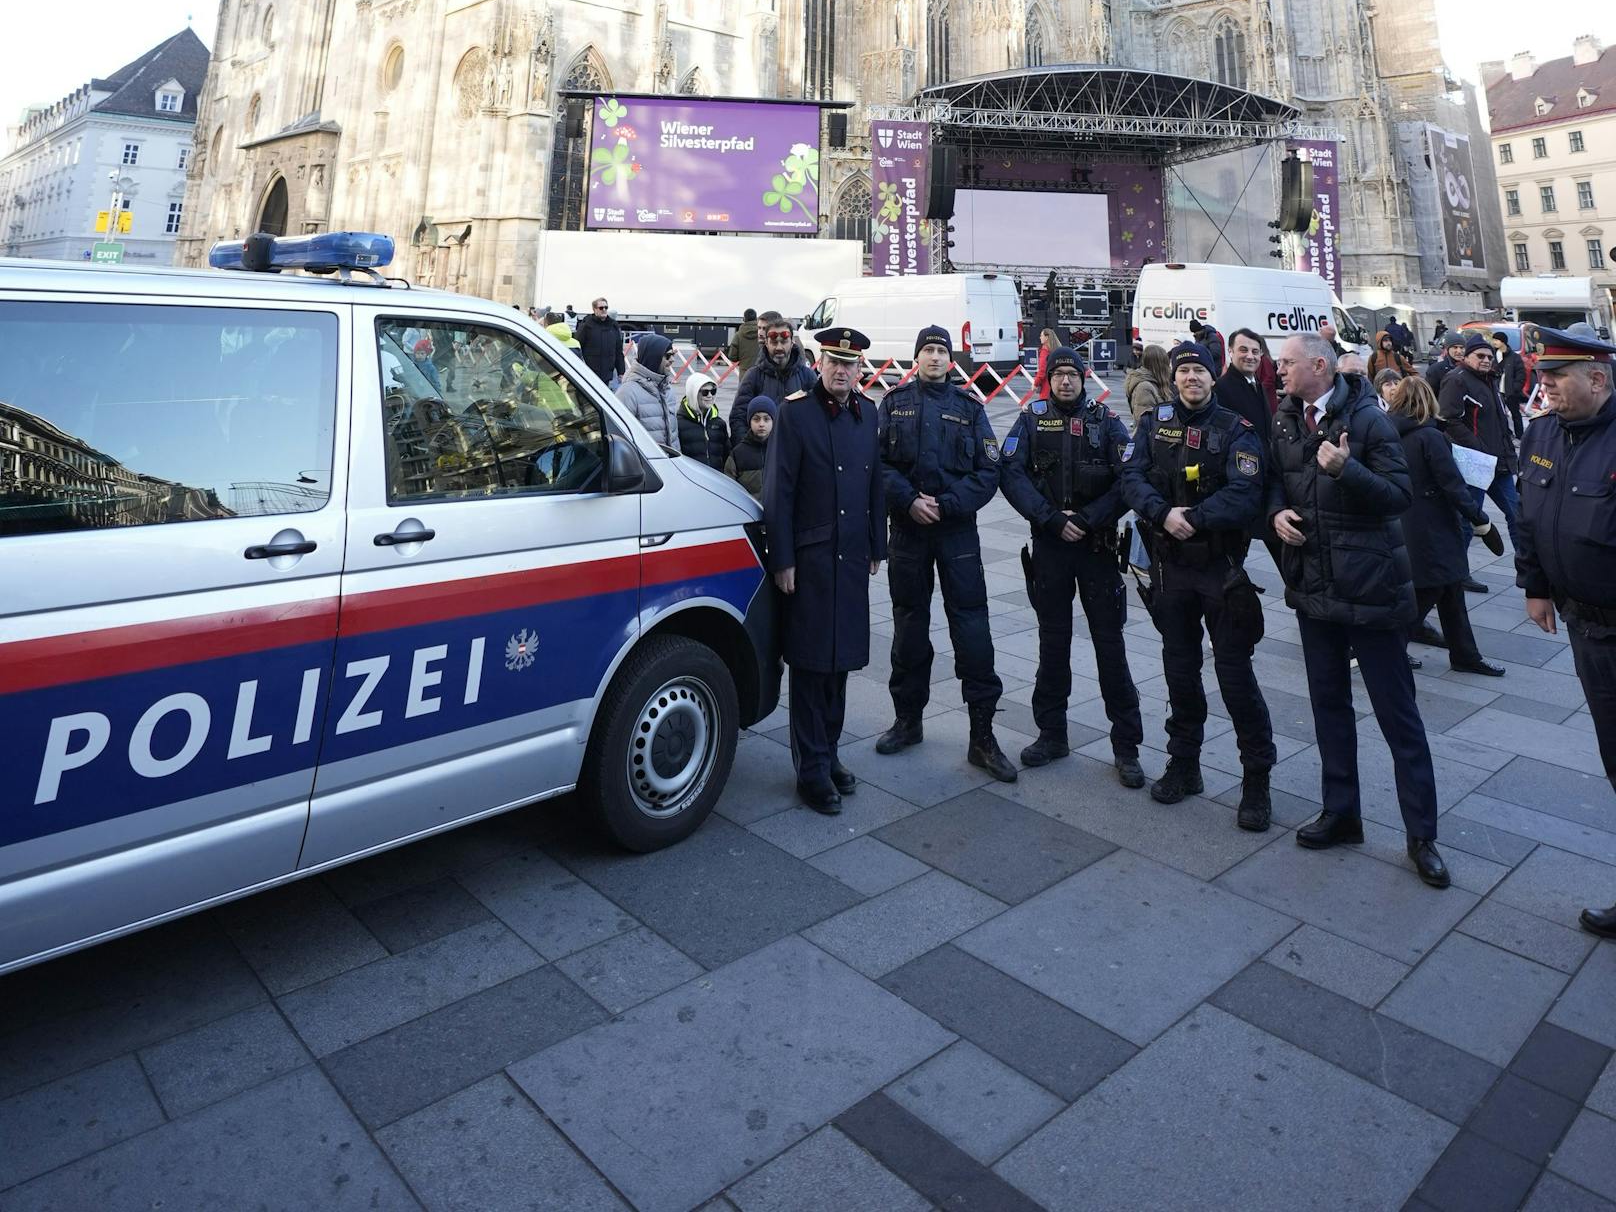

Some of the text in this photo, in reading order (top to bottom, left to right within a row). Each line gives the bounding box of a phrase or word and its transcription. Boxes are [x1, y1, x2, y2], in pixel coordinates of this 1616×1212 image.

[660, 120, 714, 136] Wiener
[897, 129, 923, 140] Stadt
[660, 134, 754, 154] Silvesterpfad
[897, 139, 923, 150] Wien
[1309, 148, 1333, 158] Stadt
[1310, 157, 1333, 168] Wien
[606, 208, 625, 216] Stadt
[96, 251, 119, 259] EXIT
[1143, 301, 1208, 320] redline
[1038, 419, 1063, 427] POLIZEI
[1158, 428, 1183, 437] POLIZEI
[34, 637, 487, 806] POLIZEI
